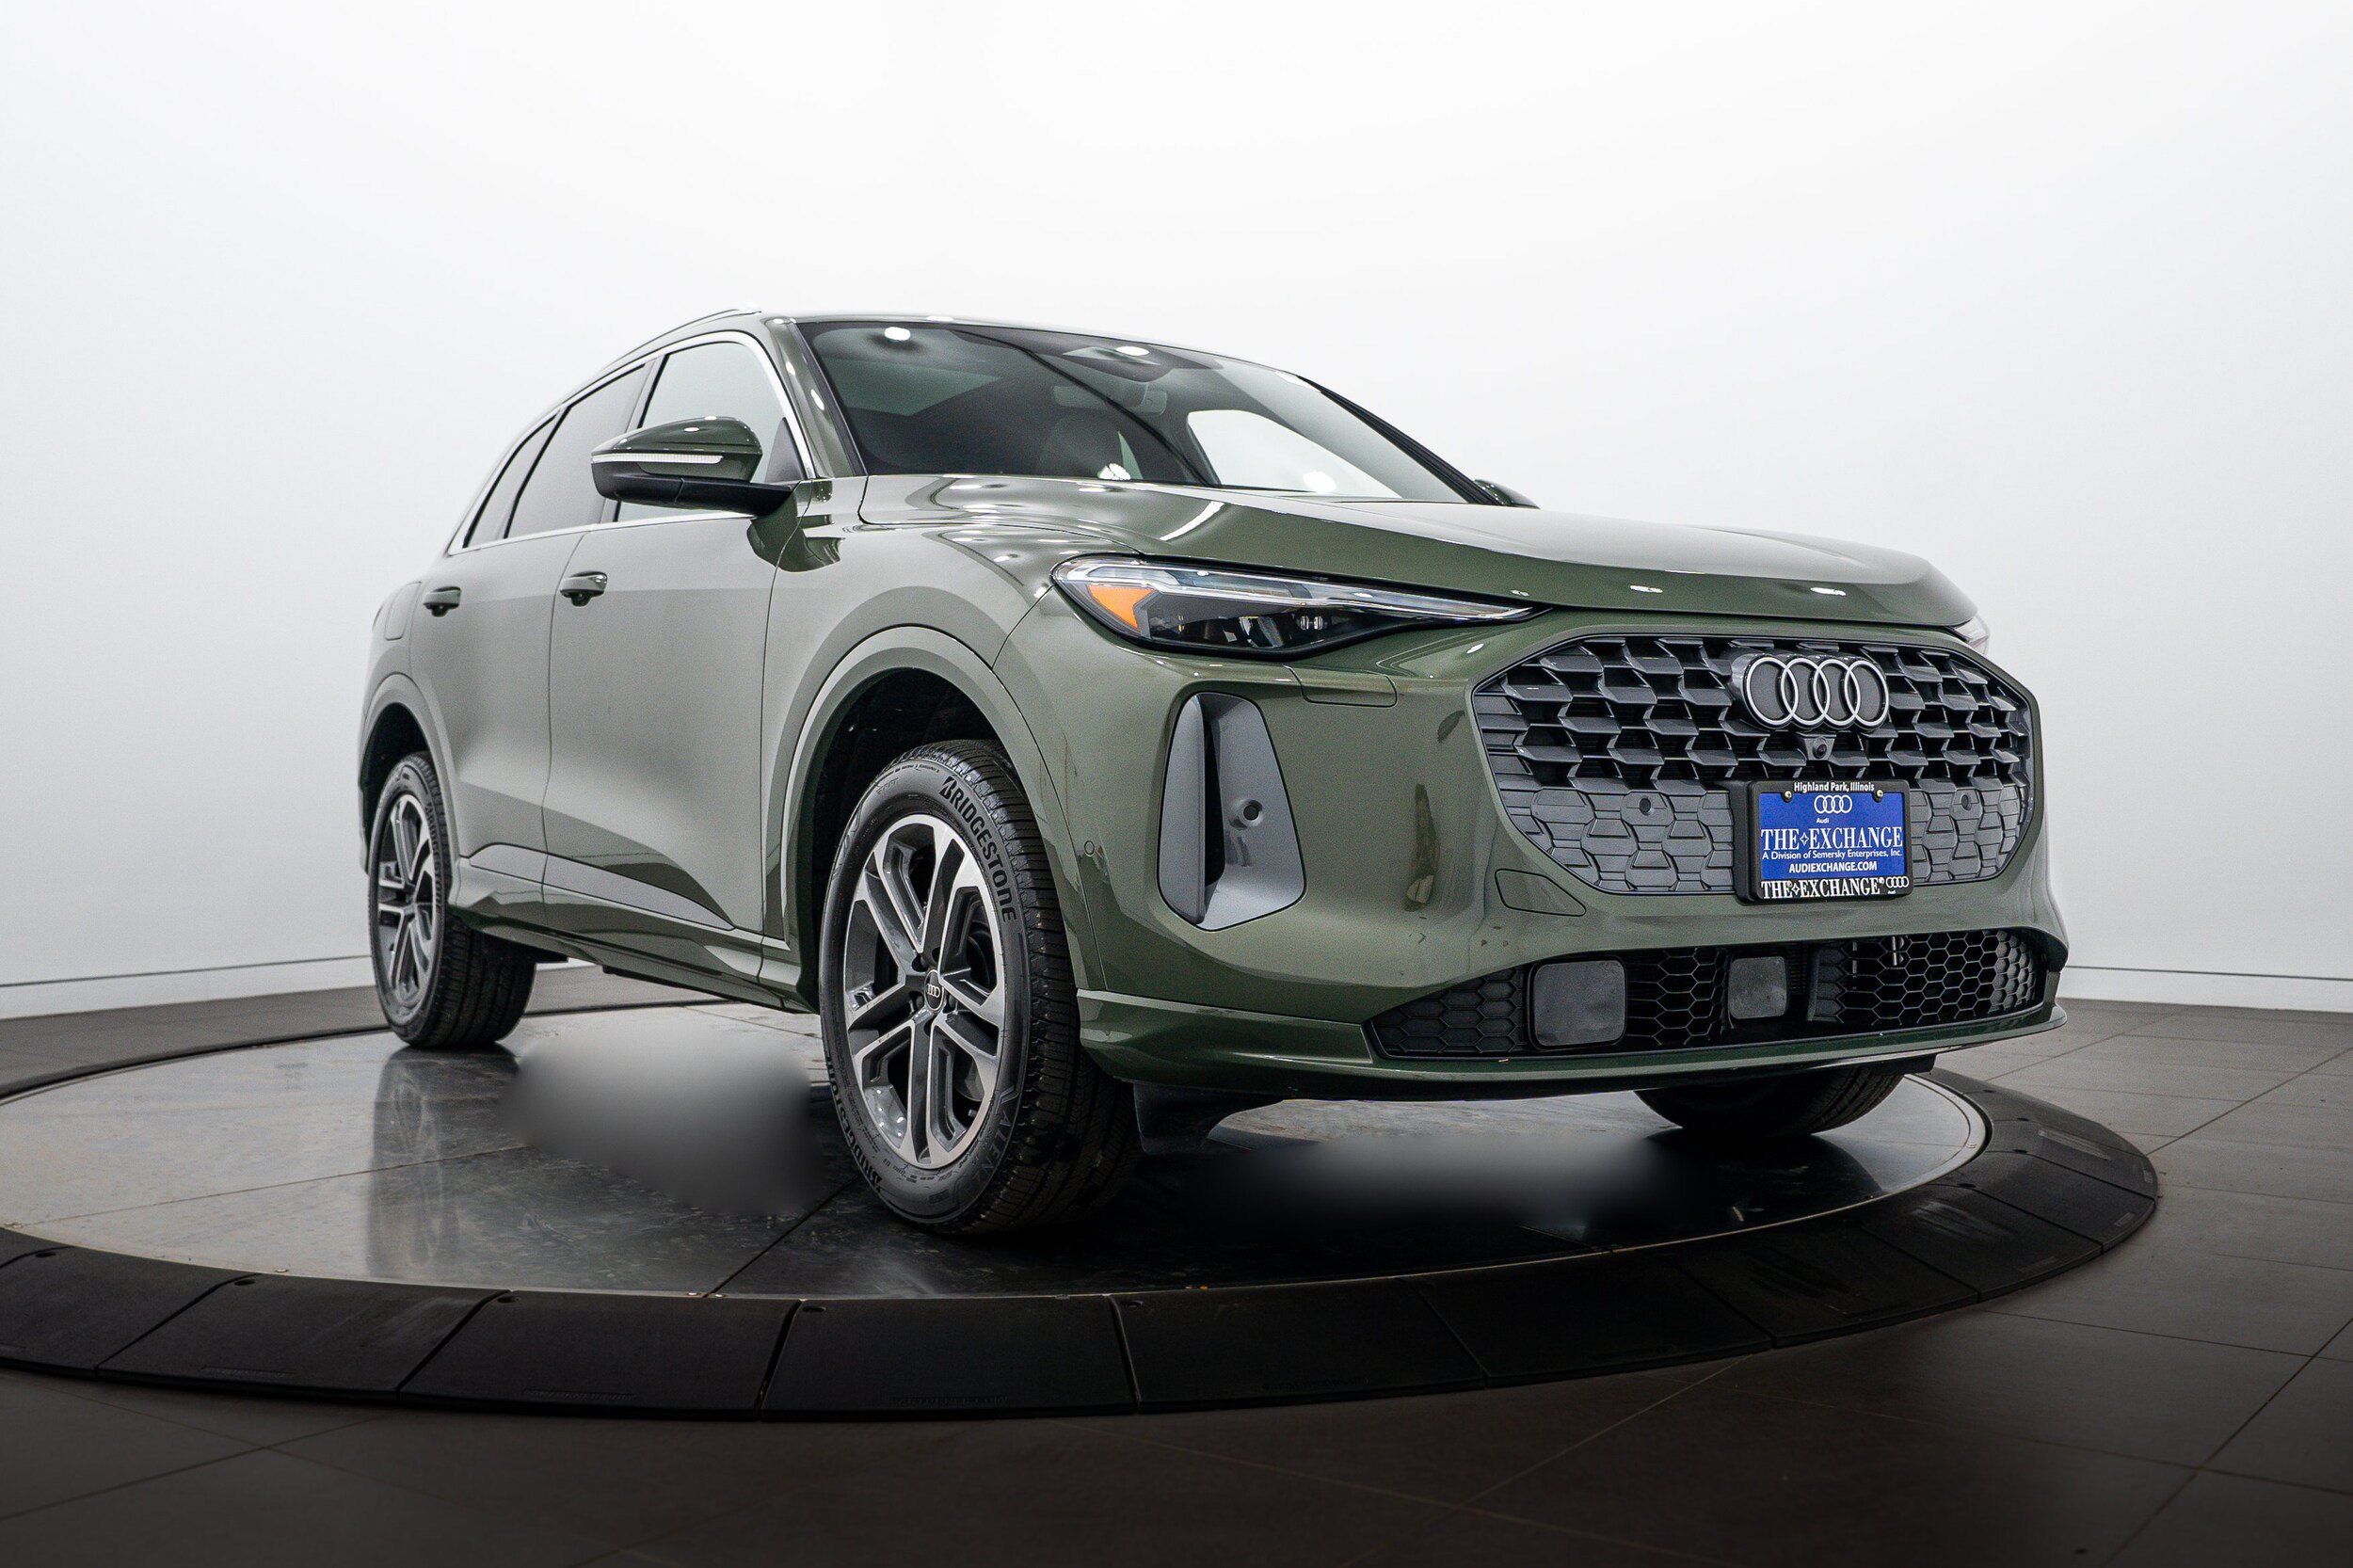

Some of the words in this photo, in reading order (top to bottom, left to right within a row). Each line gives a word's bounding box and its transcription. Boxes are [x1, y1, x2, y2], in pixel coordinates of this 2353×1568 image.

[1794, 781, 1830, 793] Highland
[1831, 781, 1849, 792] Park,
[1850, 781, 1875, 792] Illinois
[1761, 828, 1800, 850] THE
[1808, 826, 1903, 850] EXCHANGE
[939, 776, 1017, 923] BRIDGESTONE
[1770, 851, 1801, 859] Division
[1813, 850, 1846, 860] Semersky
[1890, 848, 1903, 857] Inc.
[1789, 861, 1877, 873] AUDIEXCHANGE.COM
[1761, 880, 1793, 899] THE
[1799, 877, 1881, 898] EXCHANGE
